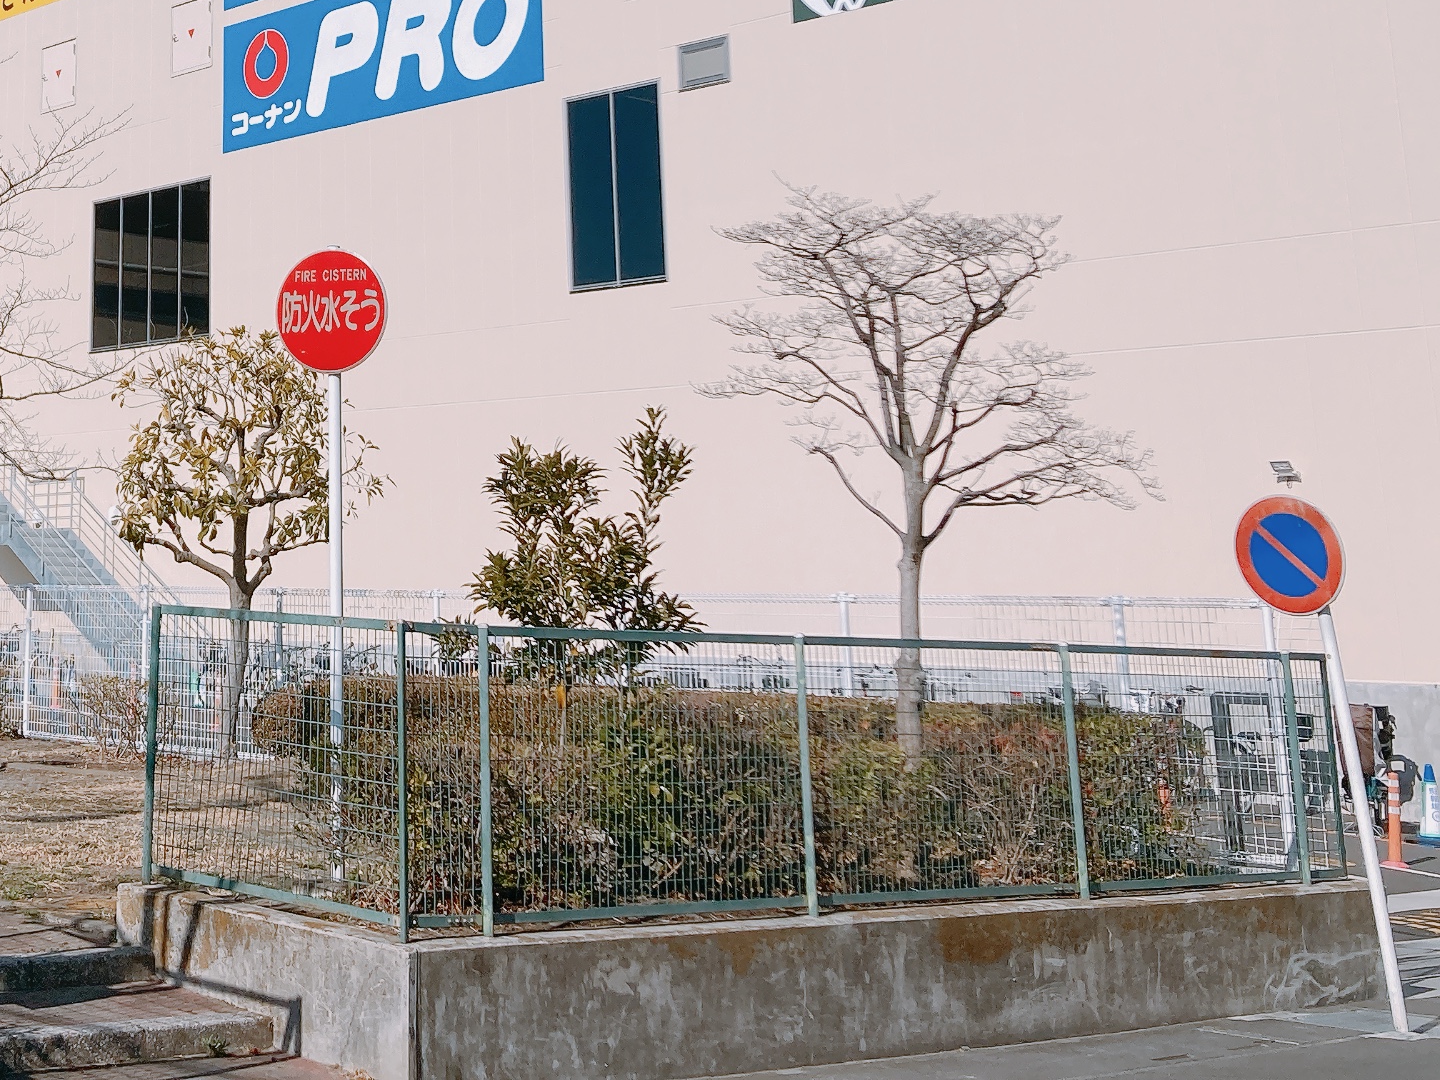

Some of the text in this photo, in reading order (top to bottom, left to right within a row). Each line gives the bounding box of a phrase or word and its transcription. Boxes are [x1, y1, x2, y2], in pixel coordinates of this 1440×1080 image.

[231, 99, 302, 137] コーナン
[294, 268, 367, 283] FIRE CISTERN
[281, 288, 381, 334] 防火水そう
